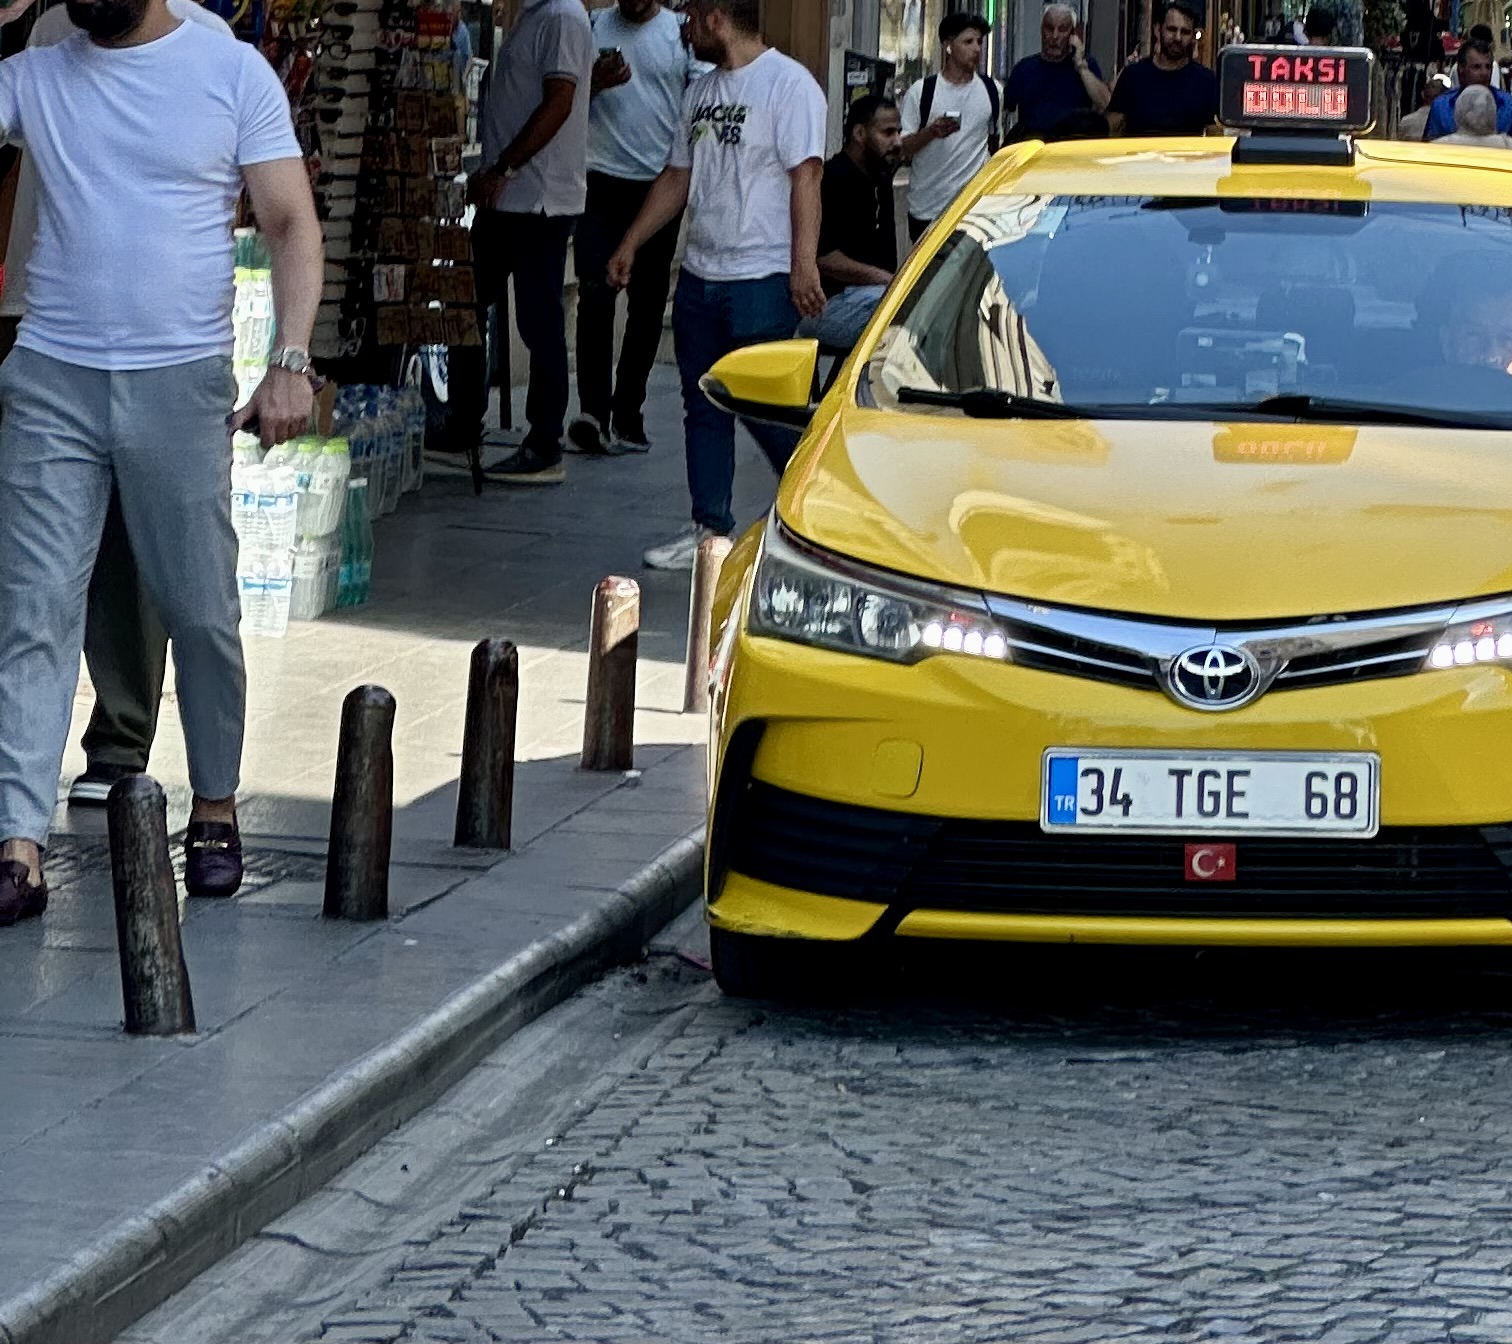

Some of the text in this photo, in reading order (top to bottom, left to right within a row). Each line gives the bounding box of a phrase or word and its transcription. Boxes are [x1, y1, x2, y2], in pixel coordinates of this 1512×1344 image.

[1054, 767, 1359, 820] TR 34 TGE 68
